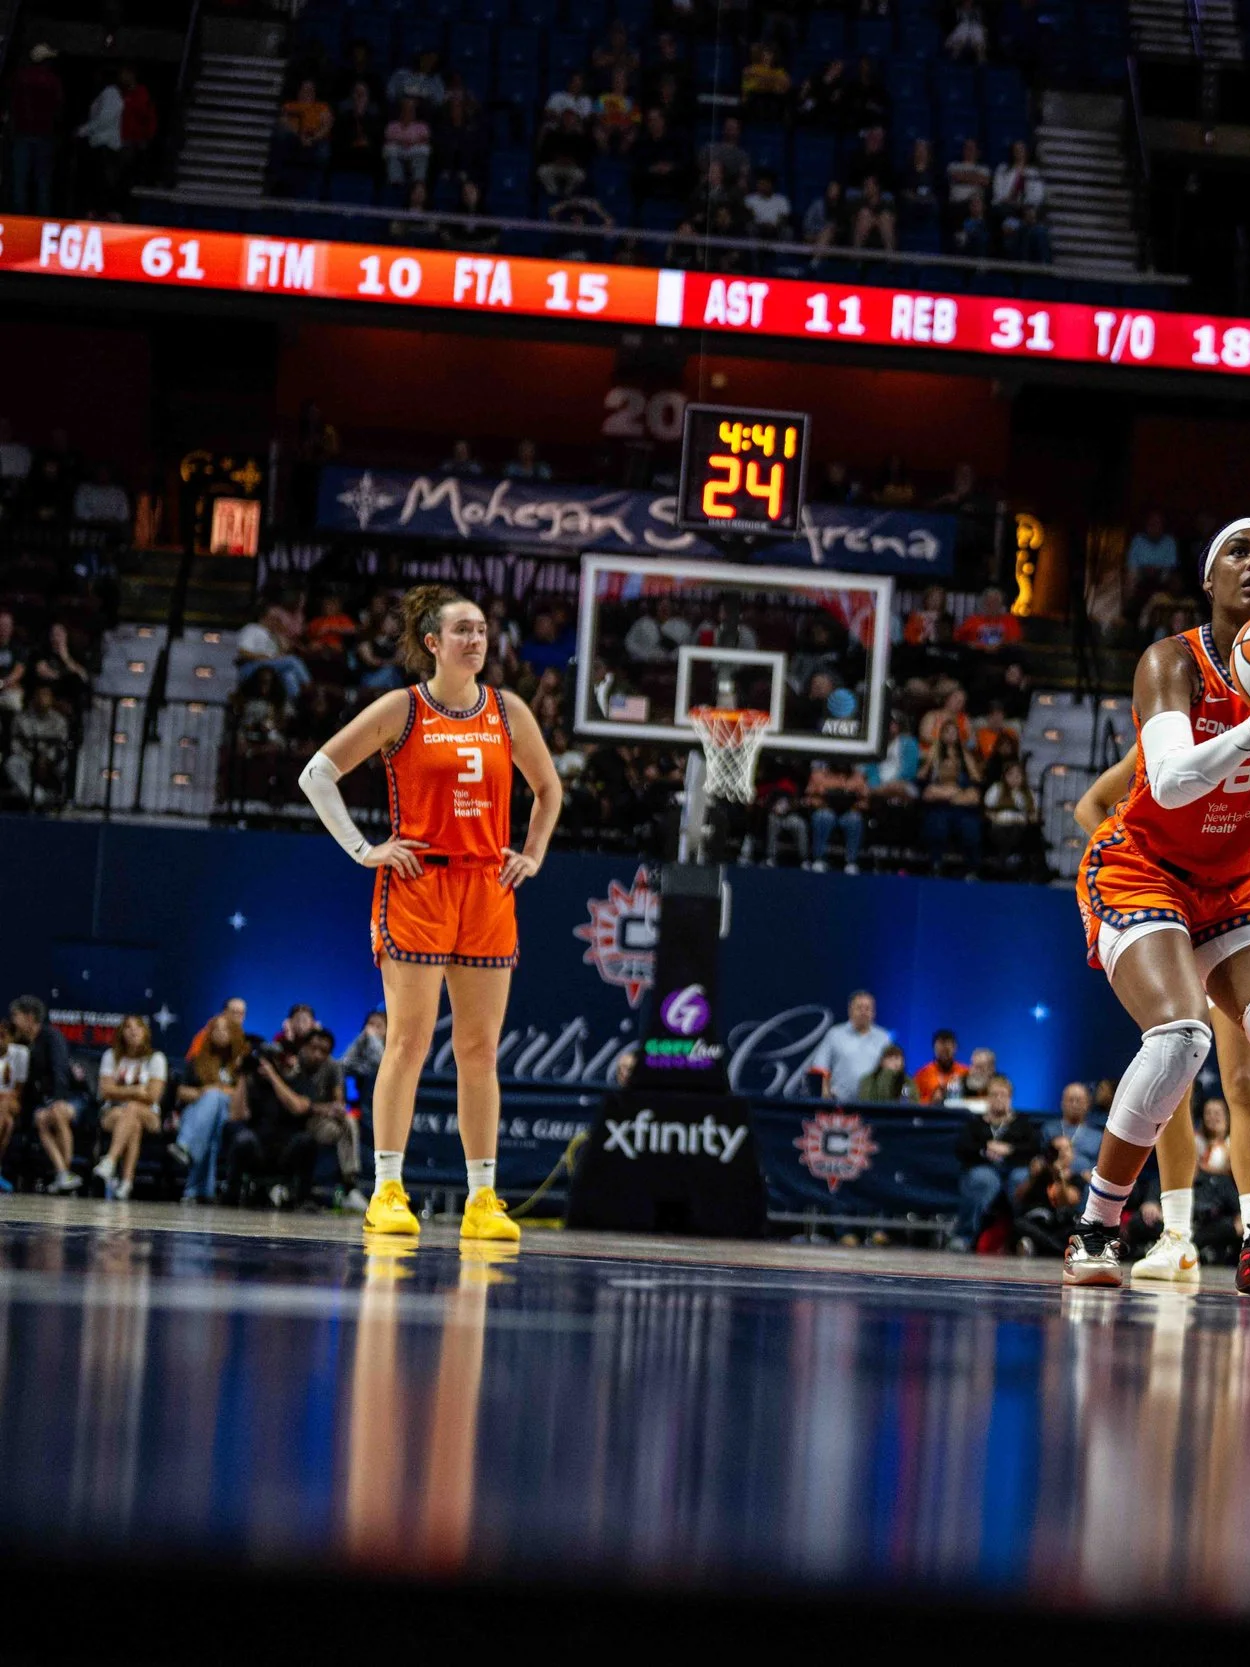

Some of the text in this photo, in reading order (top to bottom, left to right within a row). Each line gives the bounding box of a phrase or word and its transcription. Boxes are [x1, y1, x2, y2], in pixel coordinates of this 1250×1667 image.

[39, 222, 104, 273] FGA
[141, 236, 204, 280] 61
[247, 240, 314, 290] FTM
[358, 256, 421, 298] 10
[454, 257, 512, 307] FTA
[546, 271, 608, 314] 15
[704, 280, 768, 327] AST
[805, 294, 865, 336] 11
[891, 295, 957, 343] REB
[991, 308, 1052, 351] 31
[1095, 312, 1155, 363] T/O
[603, 387, 685, 440] 20
[719, 421, 796, 459] 4:41
[703, 455, 783, 520] 24
[399, 476, 635, 544] Mohegan
[423, 732, 501, 744] CONNECTICUT
[822, 718, 859, 736] AT&T
[457, 747, 483, 783] 3
[452, 789, 469, 798] Yale
[454, 807, 482, 818] Health
[1207, 802, 1229, 813] Yale
[603, 1108, 749, 1164] xfinity
